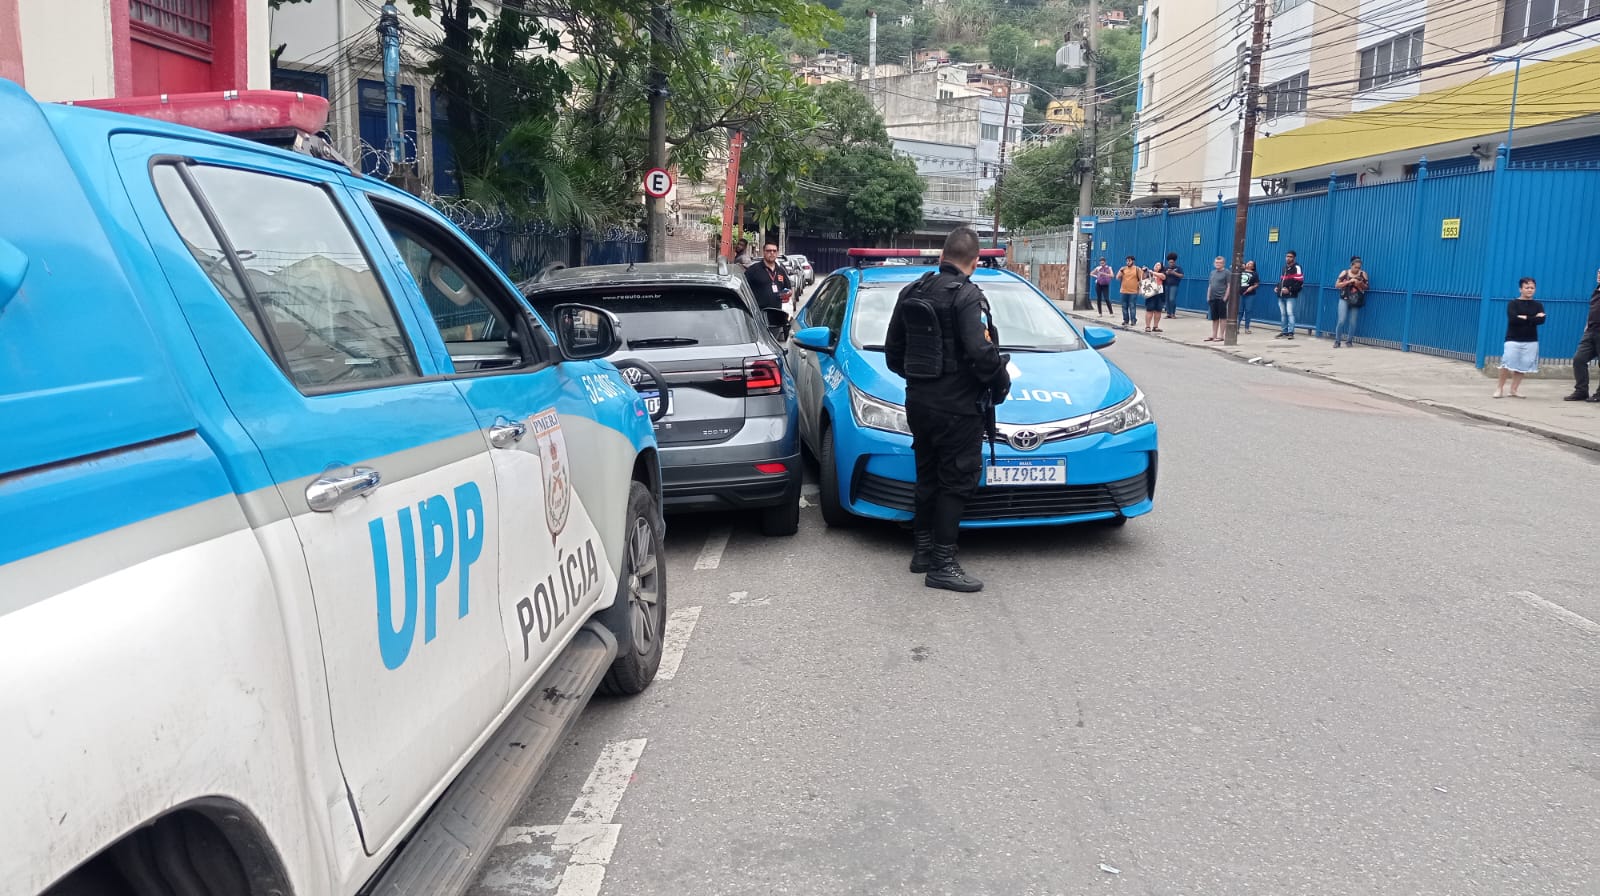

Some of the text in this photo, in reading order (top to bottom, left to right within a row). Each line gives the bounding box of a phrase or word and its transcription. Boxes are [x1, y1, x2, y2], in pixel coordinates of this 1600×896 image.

[652, 174, 664, 192] E
[1443, 226, 1458, 237] 1553
[533, 413, 559, 434] PMERJ
[993, 467, 1057, 482] LTZ9C12
[367, 481, 484, 671] UPP
[516, 538, 599, 662] POLÍCIA
